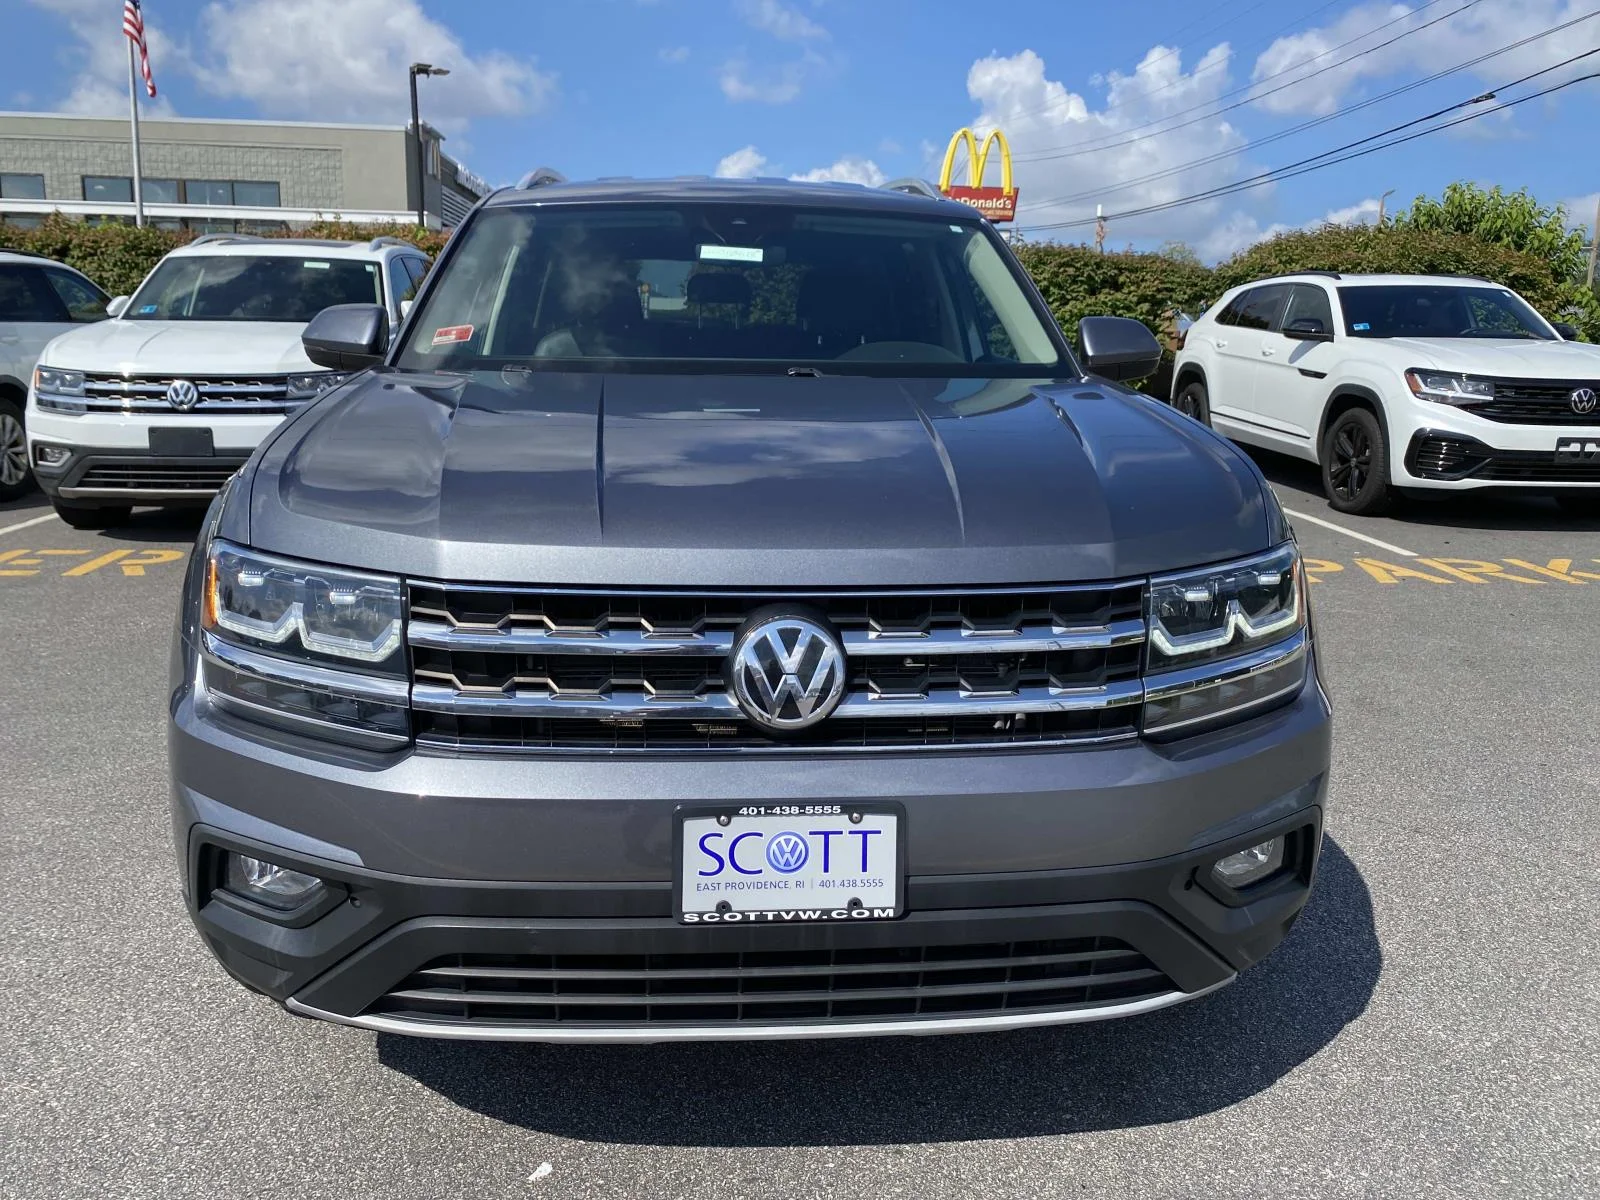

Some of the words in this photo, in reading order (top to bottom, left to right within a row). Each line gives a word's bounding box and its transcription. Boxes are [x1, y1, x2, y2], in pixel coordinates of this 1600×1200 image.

[948, 196, 1012, 209] Donald's
[1303, 557, 1600, 584] PARK
[738, 805, 841, 815] 401-438-5555
[697, 829, 882, 877] SCOTT
[696, 882, 721, 892] EAST
[725, 880, 792, 891] PROVIDENCE,
[795, 880, 805, 889] RI
[818, 878, 884, 889] 401.438.5555
[683, 908, 894, 922] SCOTTVW.COM
